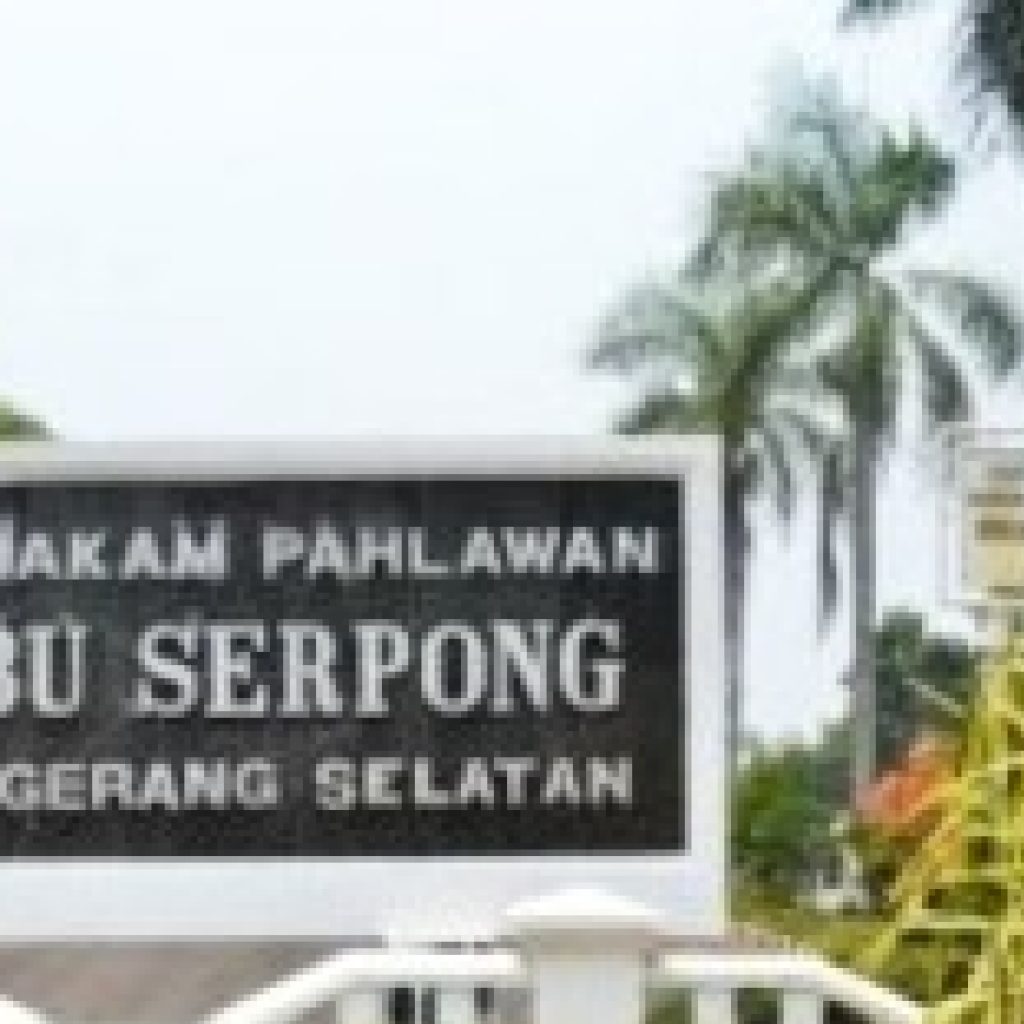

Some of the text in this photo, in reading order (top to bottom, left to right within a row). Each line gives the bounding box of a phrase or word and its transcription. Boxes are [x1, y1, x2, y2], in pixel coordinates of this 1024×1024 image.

[262, 525, 659, 580] PAHLAWAN
[132, 618, 626, 719] SERPONG
[315, 757, 633, 811] SELATAN
